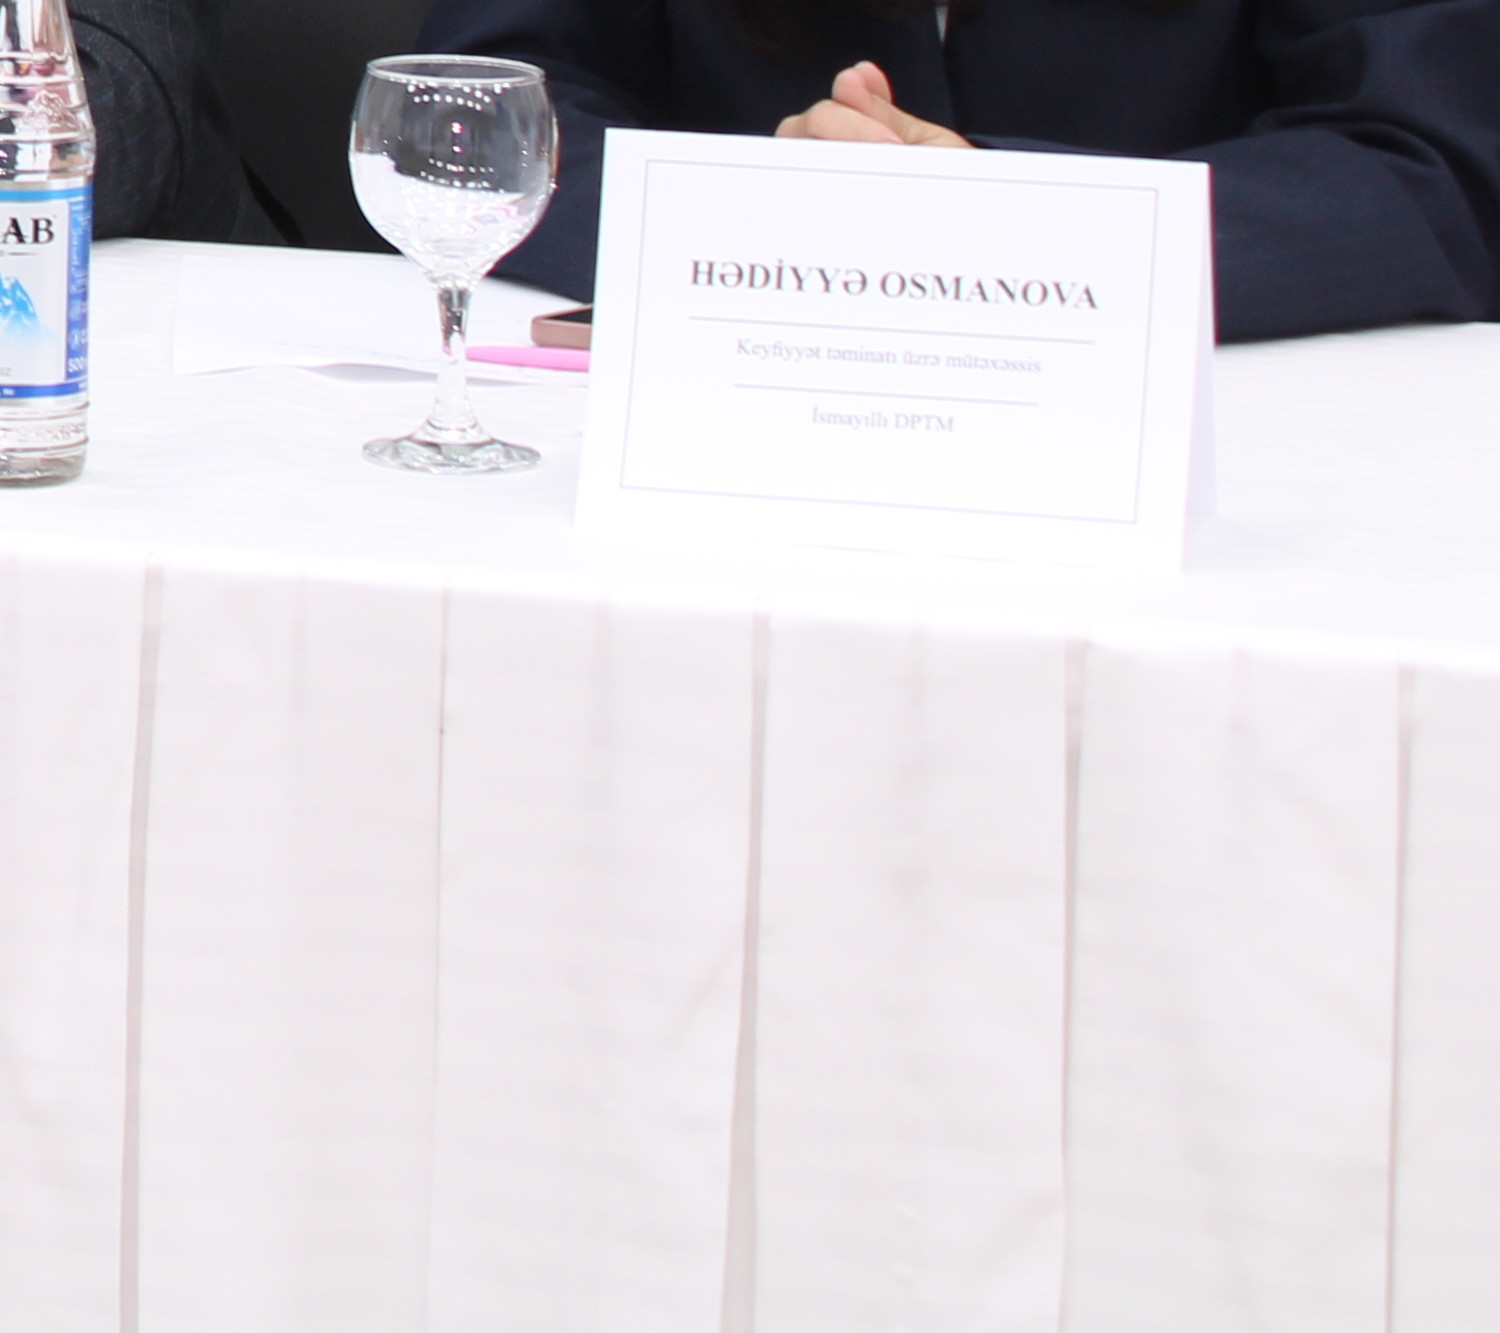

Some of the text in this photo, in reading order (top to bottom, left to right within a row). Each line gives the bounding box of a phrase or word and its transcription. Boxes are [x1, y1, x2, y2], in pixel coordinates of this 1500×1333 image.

[690, 258, 1098, 310] HƏDİYYƏ OSMANOVA
[737, 338, 1041, 373] Keyfiyyət təminatı üzrə mütəxəssis
[812, 405, 954, 432] İsmayıllı DPTM
